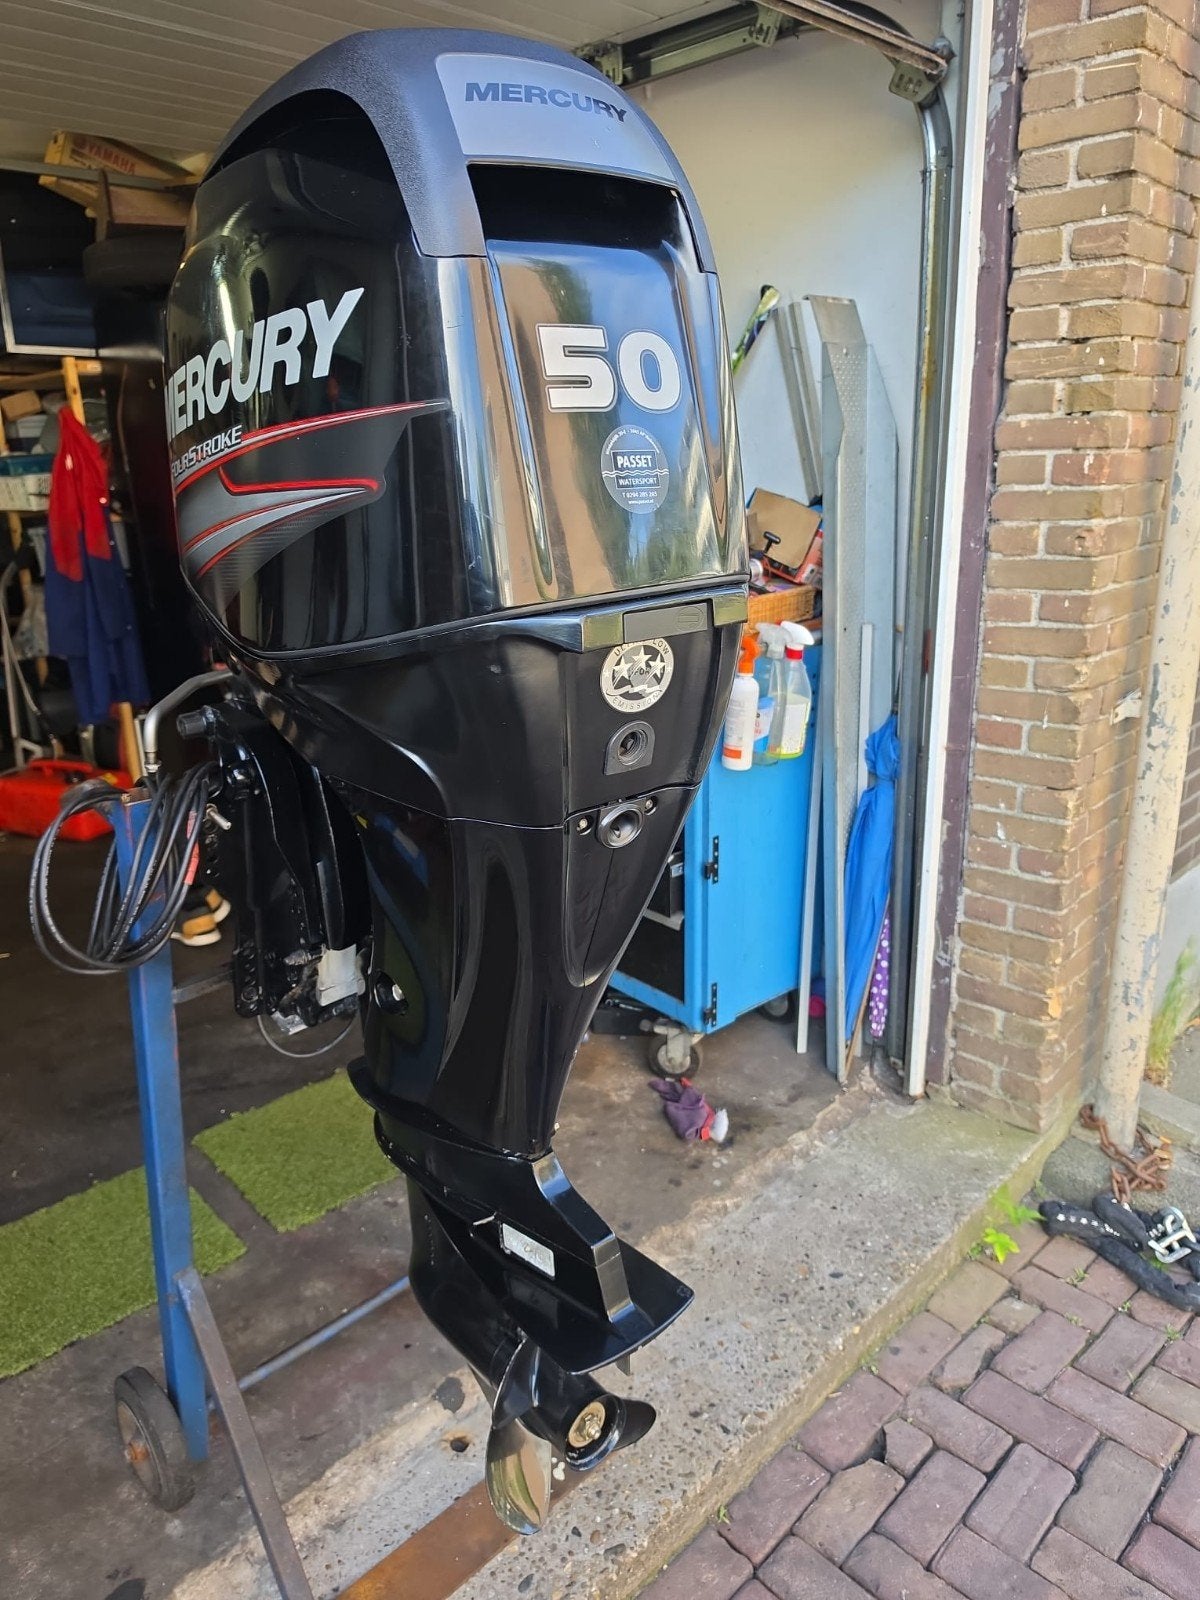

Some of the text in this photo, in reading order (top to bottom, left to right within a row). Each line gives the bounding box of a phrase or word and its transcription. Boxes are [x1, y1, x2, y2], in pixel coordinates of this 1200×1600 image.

[465, 82, 627, 123] MERCURY
[86, 144, 136, 175] YAMAHA
[164, 287, 365, 443] MERCURY
[536, 323, 682, 414] 50
[616, 455, 653, 469] PASSET
[618, 477, 658, 486] WATERSPORT
[652, 638, 670, 655] LOW
